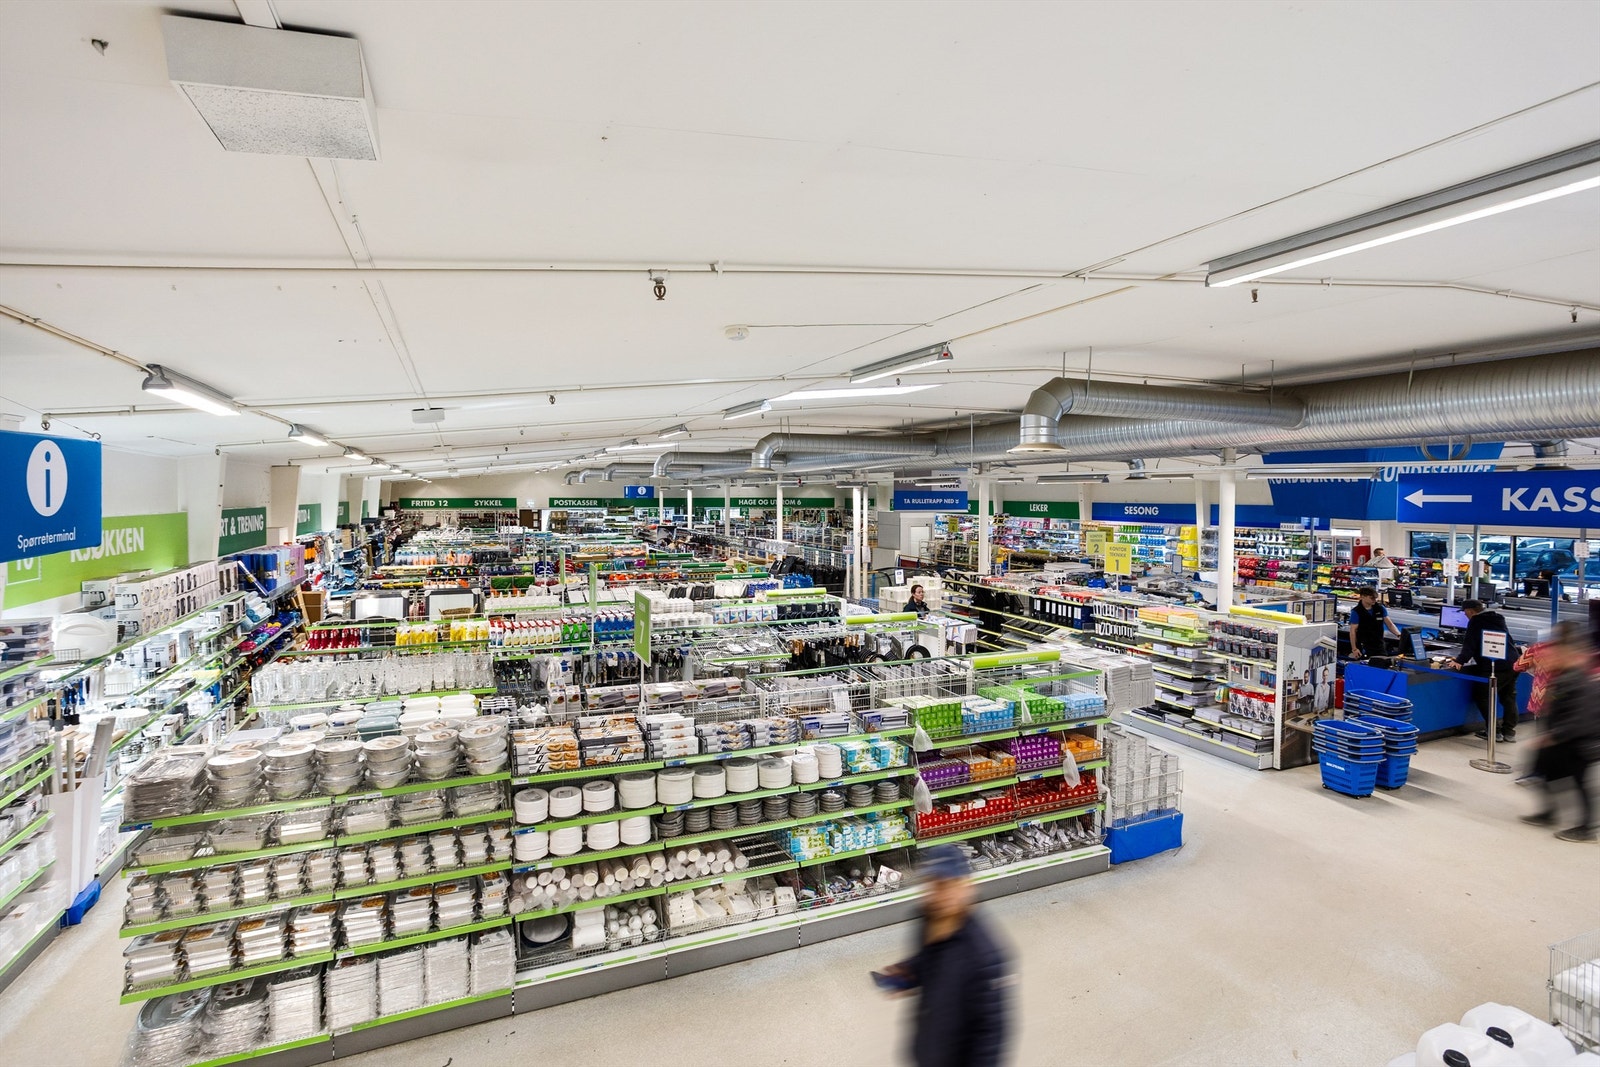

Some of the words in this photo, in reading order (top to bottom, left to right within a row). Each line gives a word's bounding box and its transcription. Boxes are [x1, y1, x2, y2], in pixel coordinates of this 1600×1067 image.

[411, 499, 436, 507] FRITID
[438, 499, 449, 507] 12
[474, 499, 503, 507] SYKKEL
[553, 499, 598, 507] POSTKASSER
[1029, 503, 1049, 512] LEKER
[1124, 506, 1159, 516] SESONG
[230, 516, 236, 535] &
[237, 513, 264, 534] TRENING
[17, 527, 76, 552] Spørreterminal
[1093, 543, 1099, 553] 2
[1114, 559, 1120, 571] 1
[640, 619, 645, 644] 7
